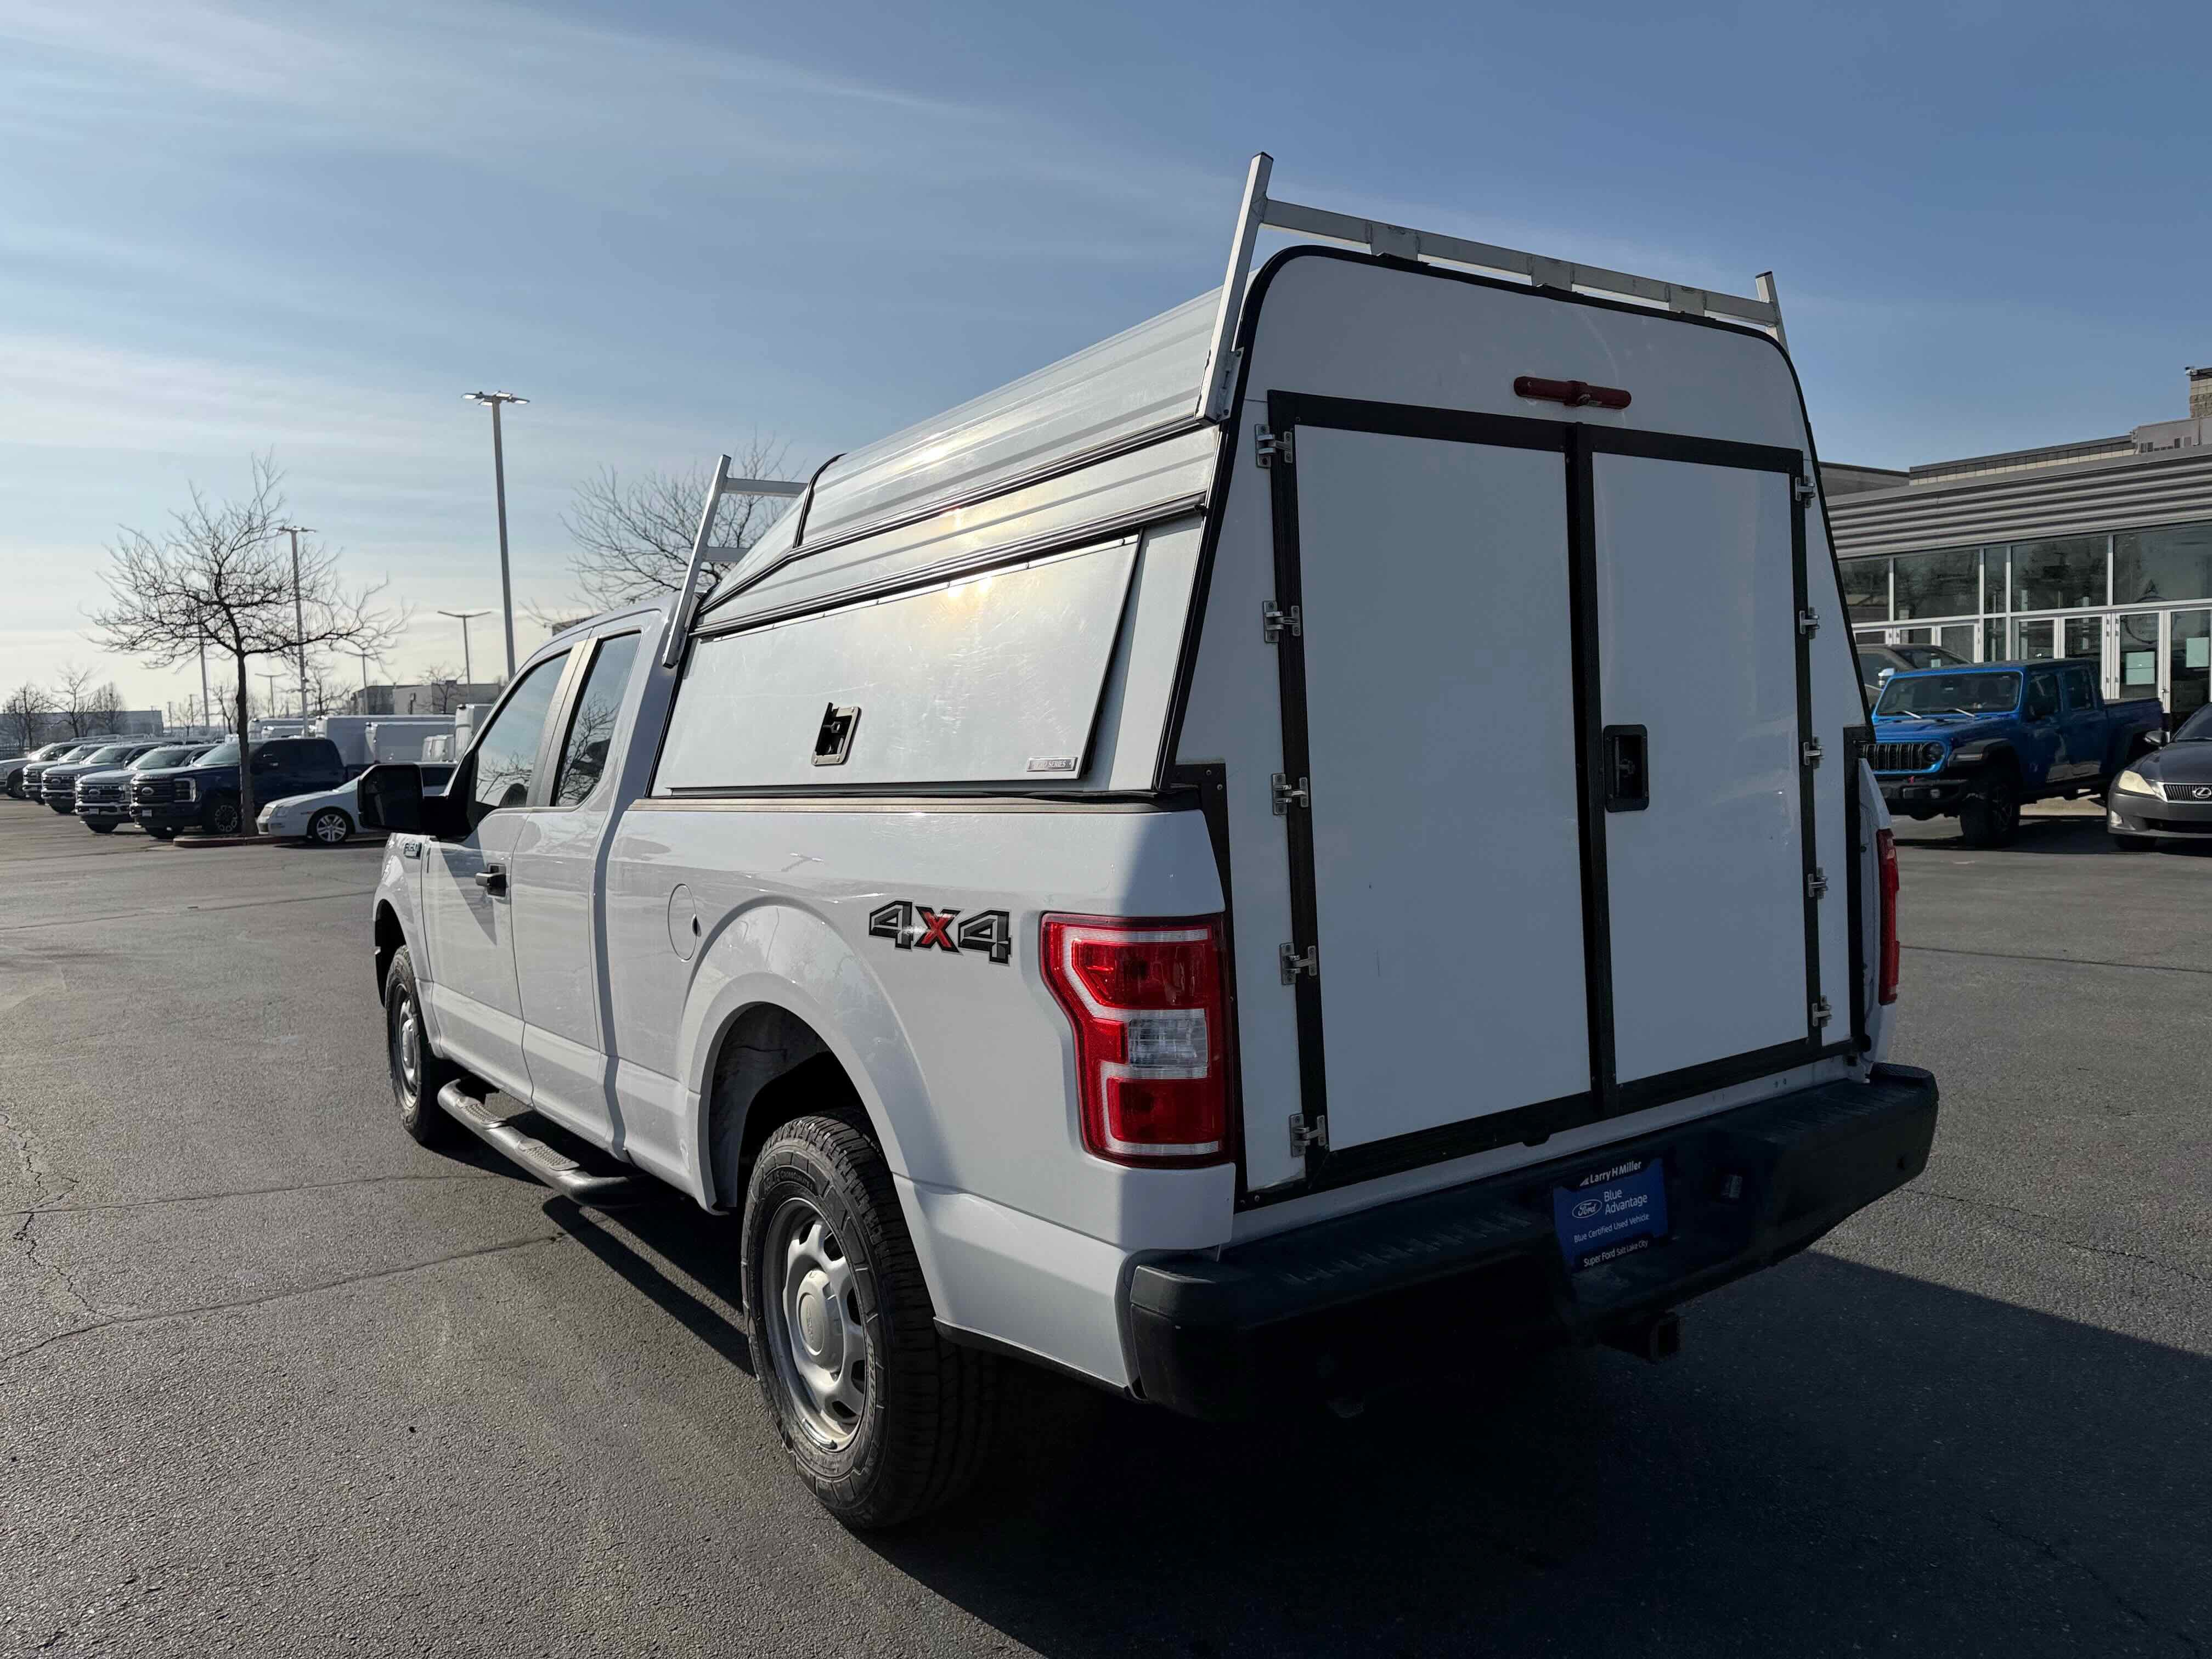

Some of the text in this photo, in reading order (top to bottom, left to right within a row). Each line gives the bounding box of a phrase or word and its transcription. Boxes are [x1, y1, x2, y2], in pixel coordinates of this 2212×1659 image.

[1590, 1161, 1642, 1184] Larry H Miller
[1604, 1189, 1622, 1201] Blue
[1605, 1194, 1647, 1215] Advantage
[1578, 1202, 1597, 1216] Ford
[1573, 1214, 1649, 1243] Blue Certified Used Vehicle
[1584, 1239, 1649, 1267] Super Ford Salt Lake City
